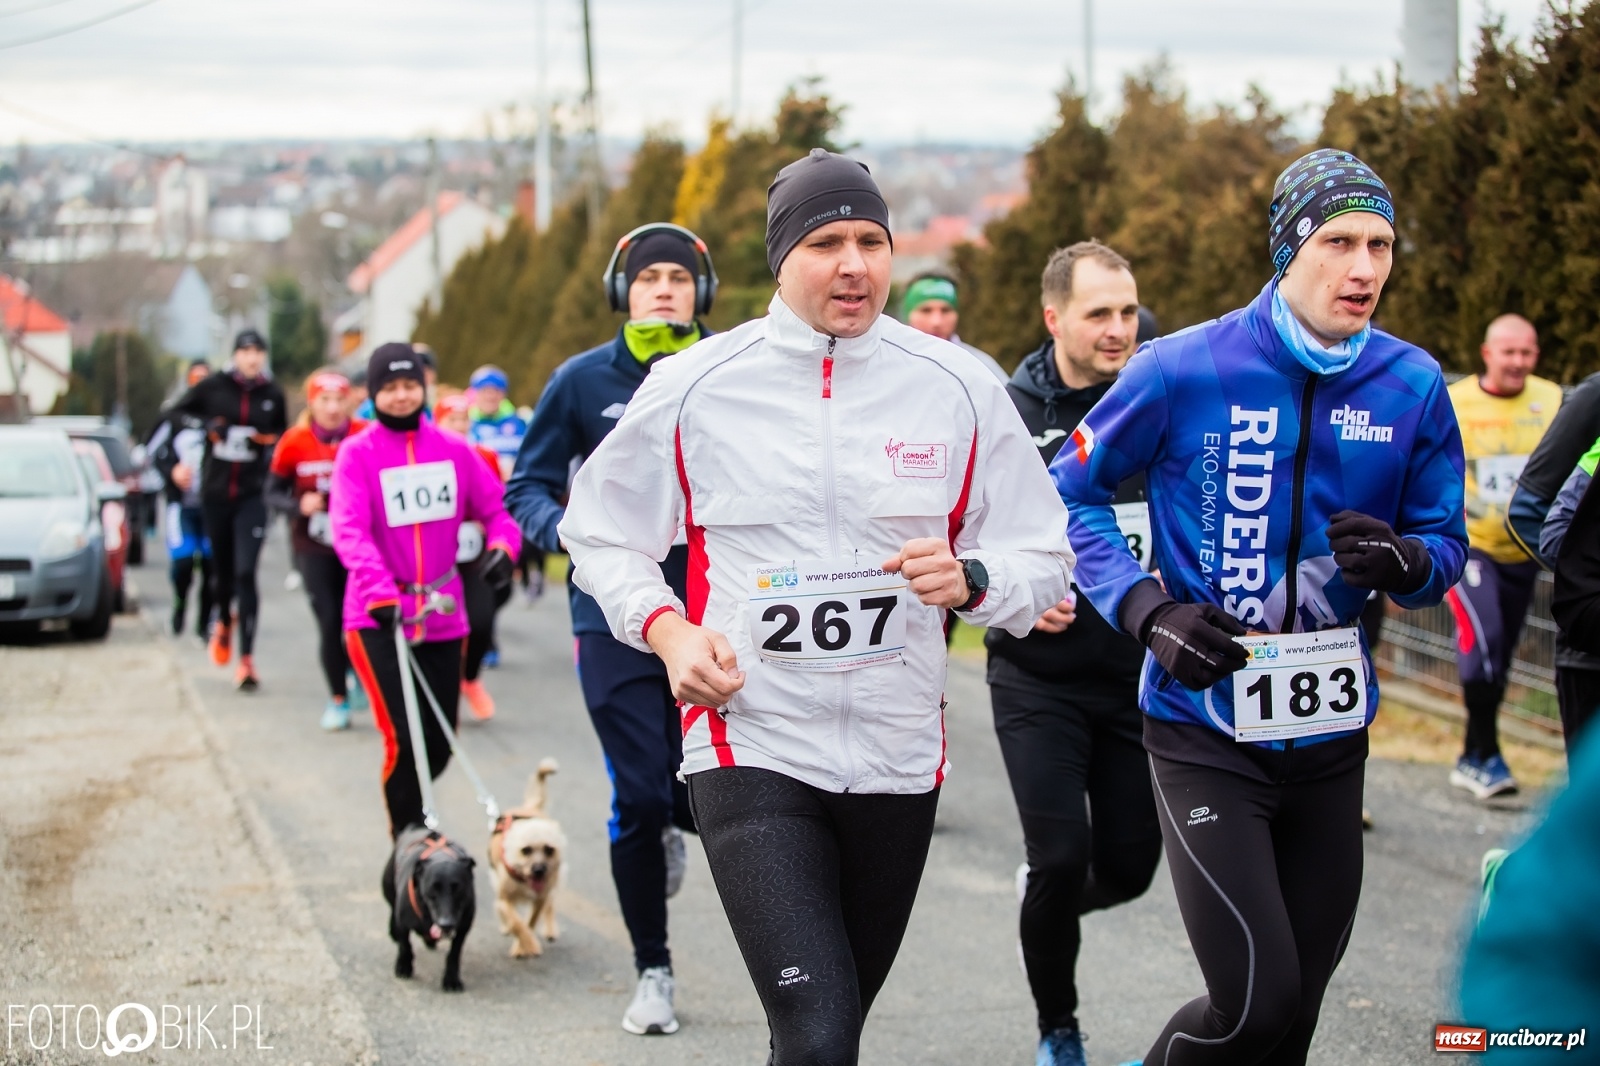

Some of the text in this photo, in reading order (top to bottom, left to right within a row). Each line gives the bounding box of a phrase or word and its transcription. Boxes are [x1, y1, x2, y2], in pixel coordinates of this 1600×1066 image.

[1348, 190, 1370, 198] atelier
[804, 210, 838, 227] ARTENGO
[885, 438, 905, 458] Virgin
[1201, 432, 1220, 532] EKO-OKNA
[392, 483, 451, 512] 104
[1220, 405, 1279, 625] RIDERS
[761, 595, 898, 653] 267
[1241, 639, 1357, 655] PersonaBest www.personalbest.pl
[1246, 667, 1359, 721] 183
[1187, 813, 1218, 827] Kalenji
[778, 974, 810, 987] Kalenji
